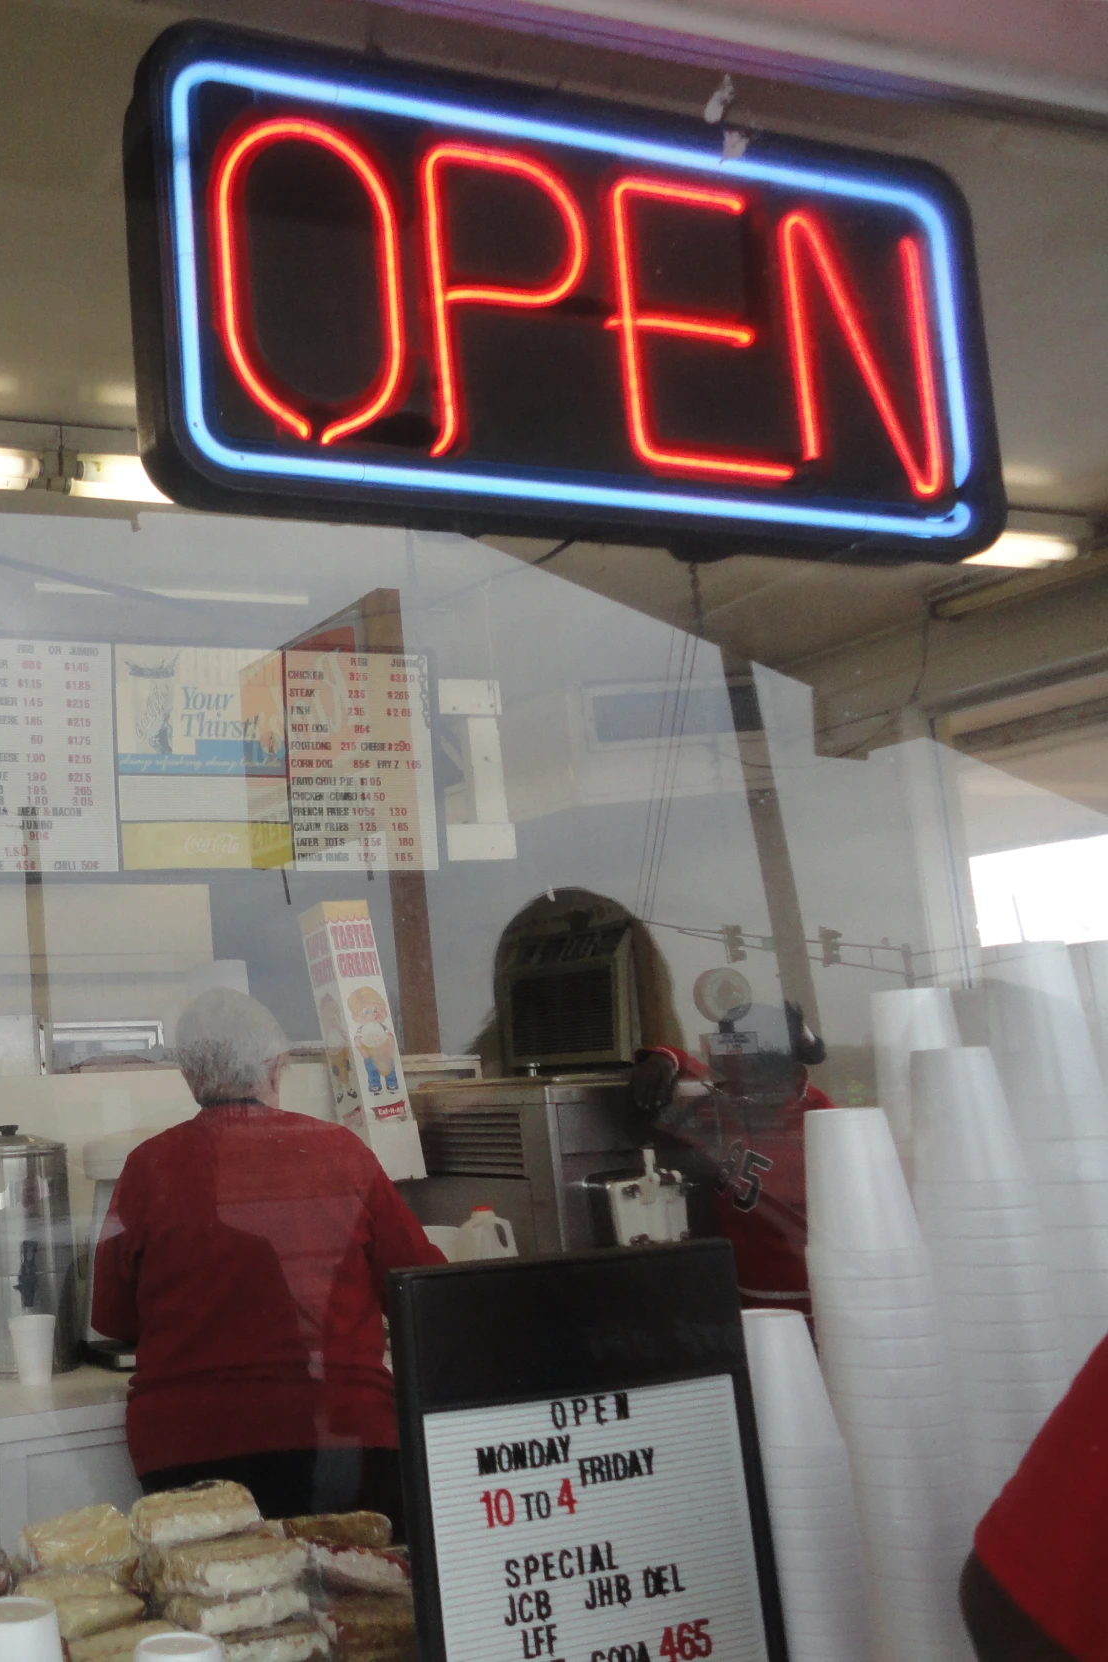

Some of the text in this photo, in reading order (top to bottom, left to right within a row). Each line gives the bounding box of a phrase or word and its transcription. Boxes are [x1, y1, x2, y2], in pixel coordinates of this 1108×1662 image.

[209, 115, 945, 498] OPEN
[49, 646, 61, 655] OR
[69, 646, 99, 656] JUMBO
[288, 671, 324, 680] CHICKEN
[289, 689, 315, 697] STEAK
[181, 686, 236, 710] Your
[291, 706, 310, 715] FISH
[180, 713, 259, 740] Thirst!
[291, 724, 328, 733] HOT DOG
[291, 742, 331, 750] FOOTLONG
[291, 760, 314, 768] CORN
[316, 760, 333, 768] DOG
[315, 778, 336, 786] CHILI
[340, 778, 354, 786] PIE
[292, 792, 324, 801] CHICKEN
[17, 807, 39, 816] MEAT
[43, 807, 51, 816] &
[52, 807, 82, 816] BACON
[293, 807, 349, 816] FRENCH FRIES
[20, 820, 53, 830] JUMBO
[294, 823, 321, 831] CAJUN
[325, 823, 349, 832] FRIES
[359, 823, 377, 831] 125
[296, 838, 345, 846] TATER TOTS
[298, 853, 322, 862] ONION
[54, 861, 76, 870] CHILI
[330, 923, 374, 950] TASTES
[551, 1392, 630, 1430] OPEN
[476, 1434, 571, 1477] MONDAY
[578, 1447, 655, 1487] FRIDAY
[479, 1478, 578, 1528] 10 TO 4
[504, 1541, 619, 1588] SPECIAL
[504, 1564, 687, 1627] JCB JHB DEL
[521, 1624, 558, 1660] LFF
[659, 1618, 713, 1662] 465
